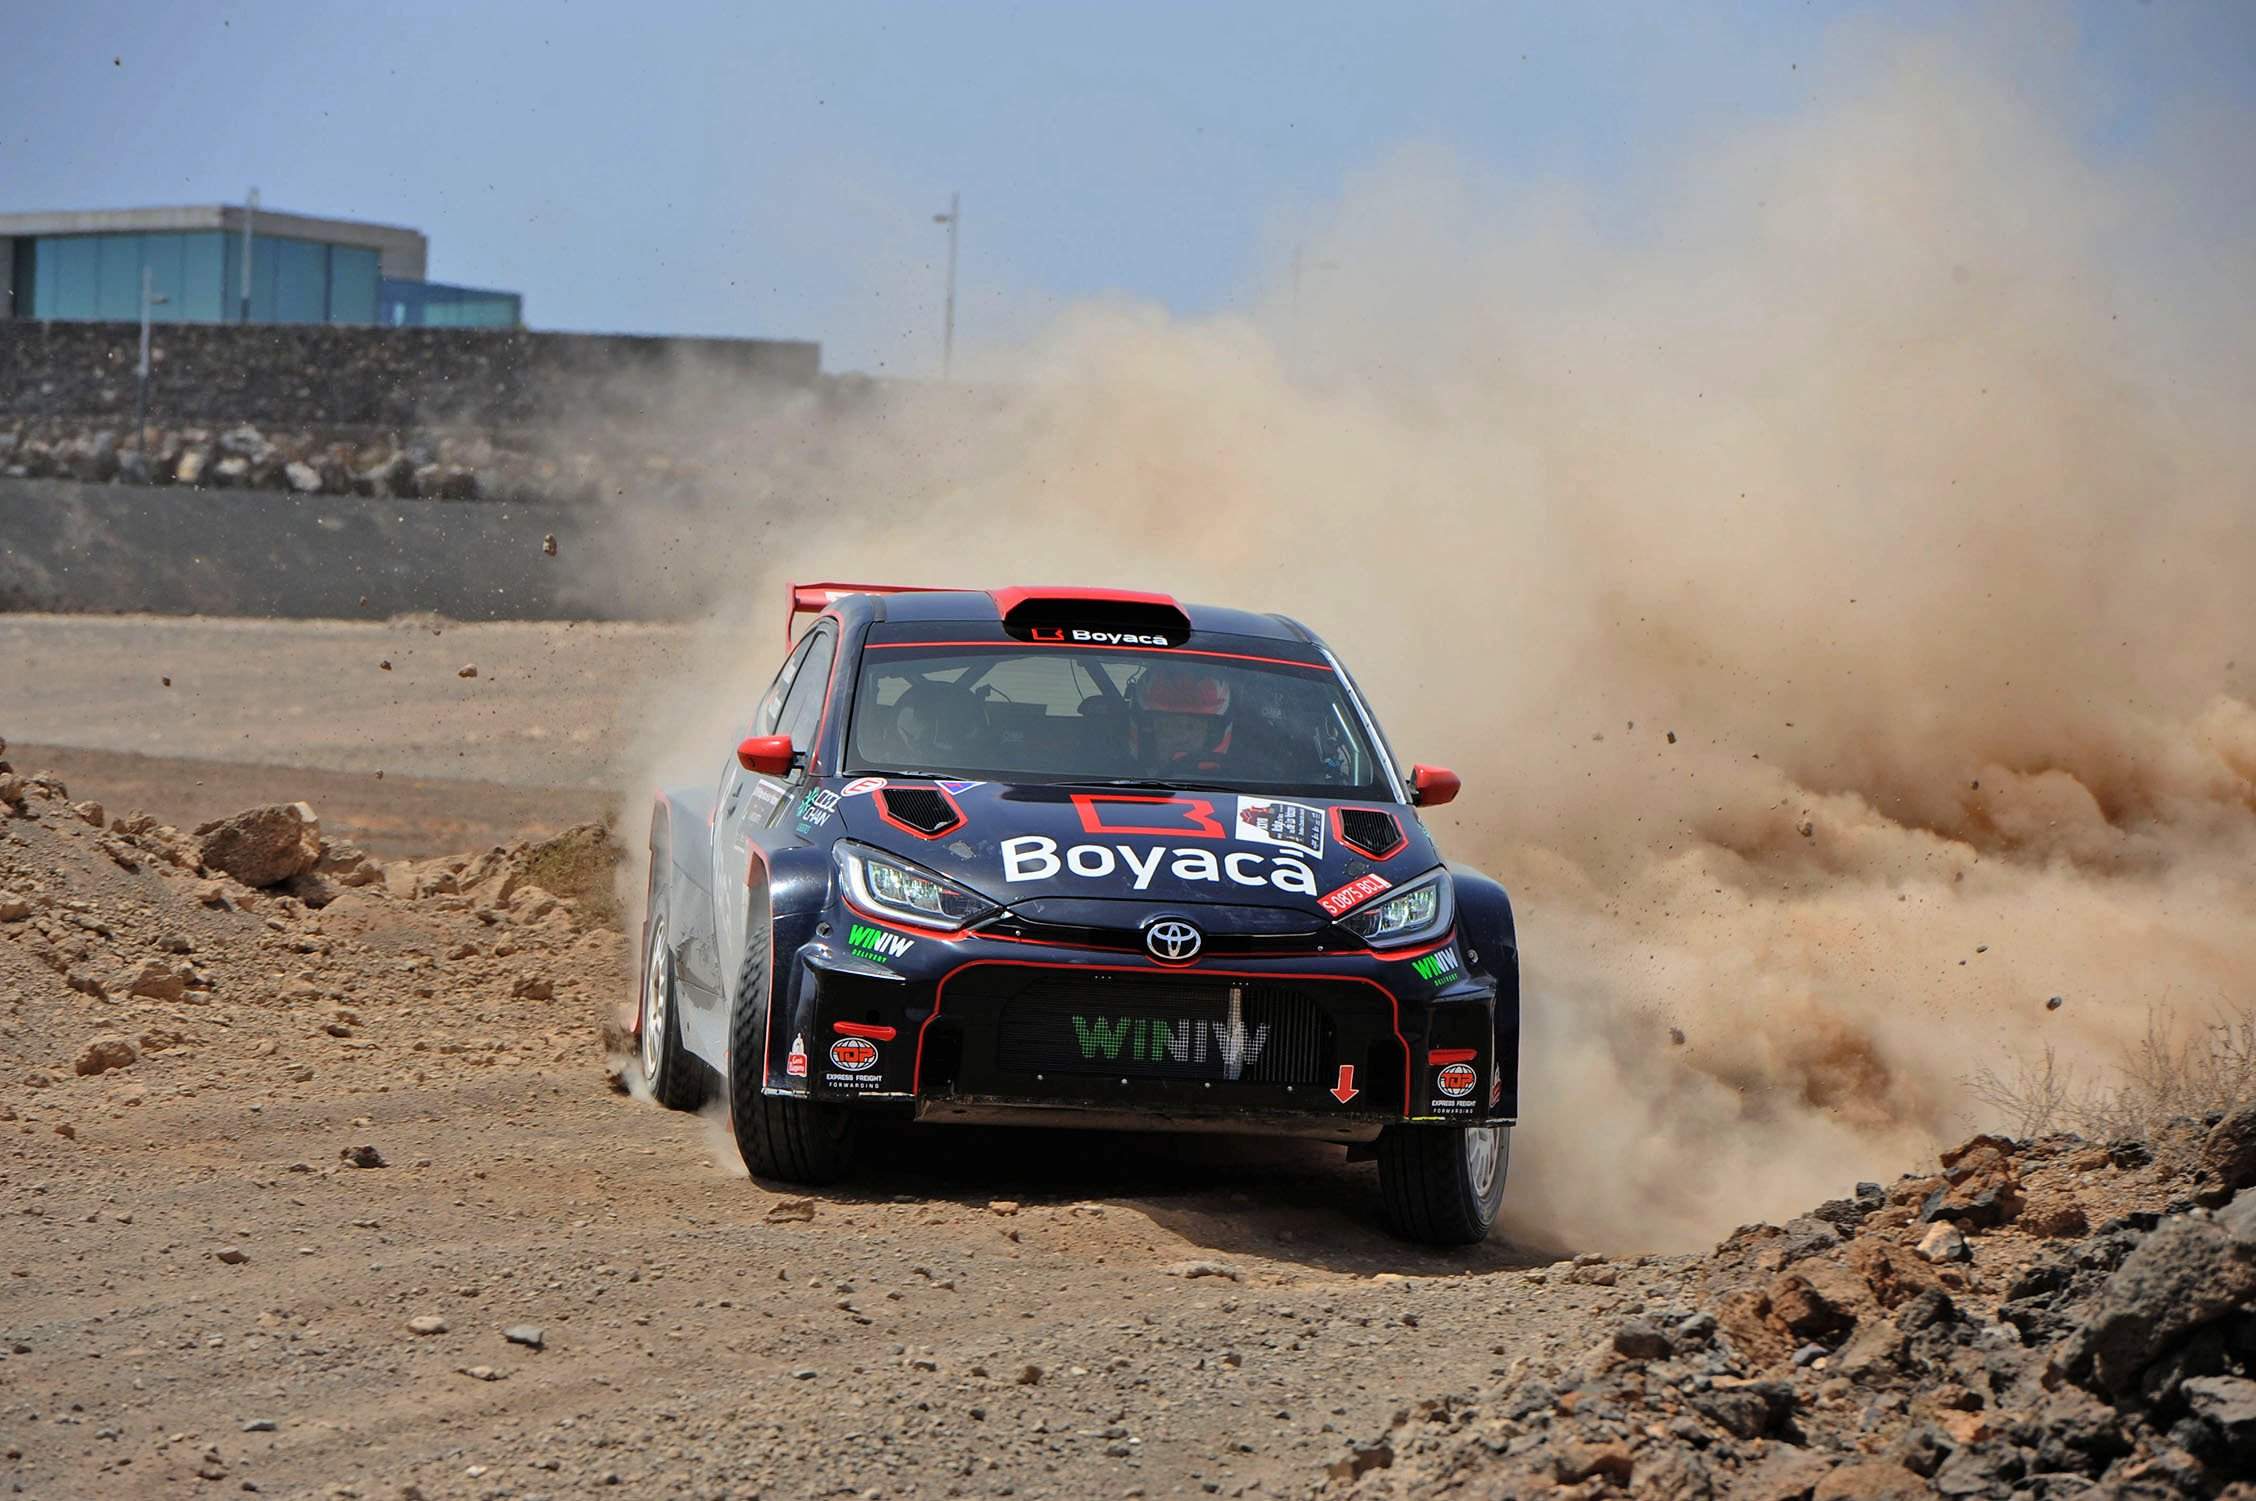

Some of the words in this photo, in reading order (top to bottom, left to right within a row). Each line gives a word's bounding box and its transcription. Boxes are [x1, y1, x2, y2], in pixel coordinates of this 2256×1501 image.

[1000, 835, 1318, 897] Boyacá
[1331, 887, 1364, 909] 0875
[833, 1046, 875, 1063] TOP
[826, 1073, 854, 1081] EXPRESS
[855, 1074, 882, 1082] FREIGHT
[829, 1081, 880, 1089] FORWARDING
[1441, 1072, 1473, 1089] TOP
